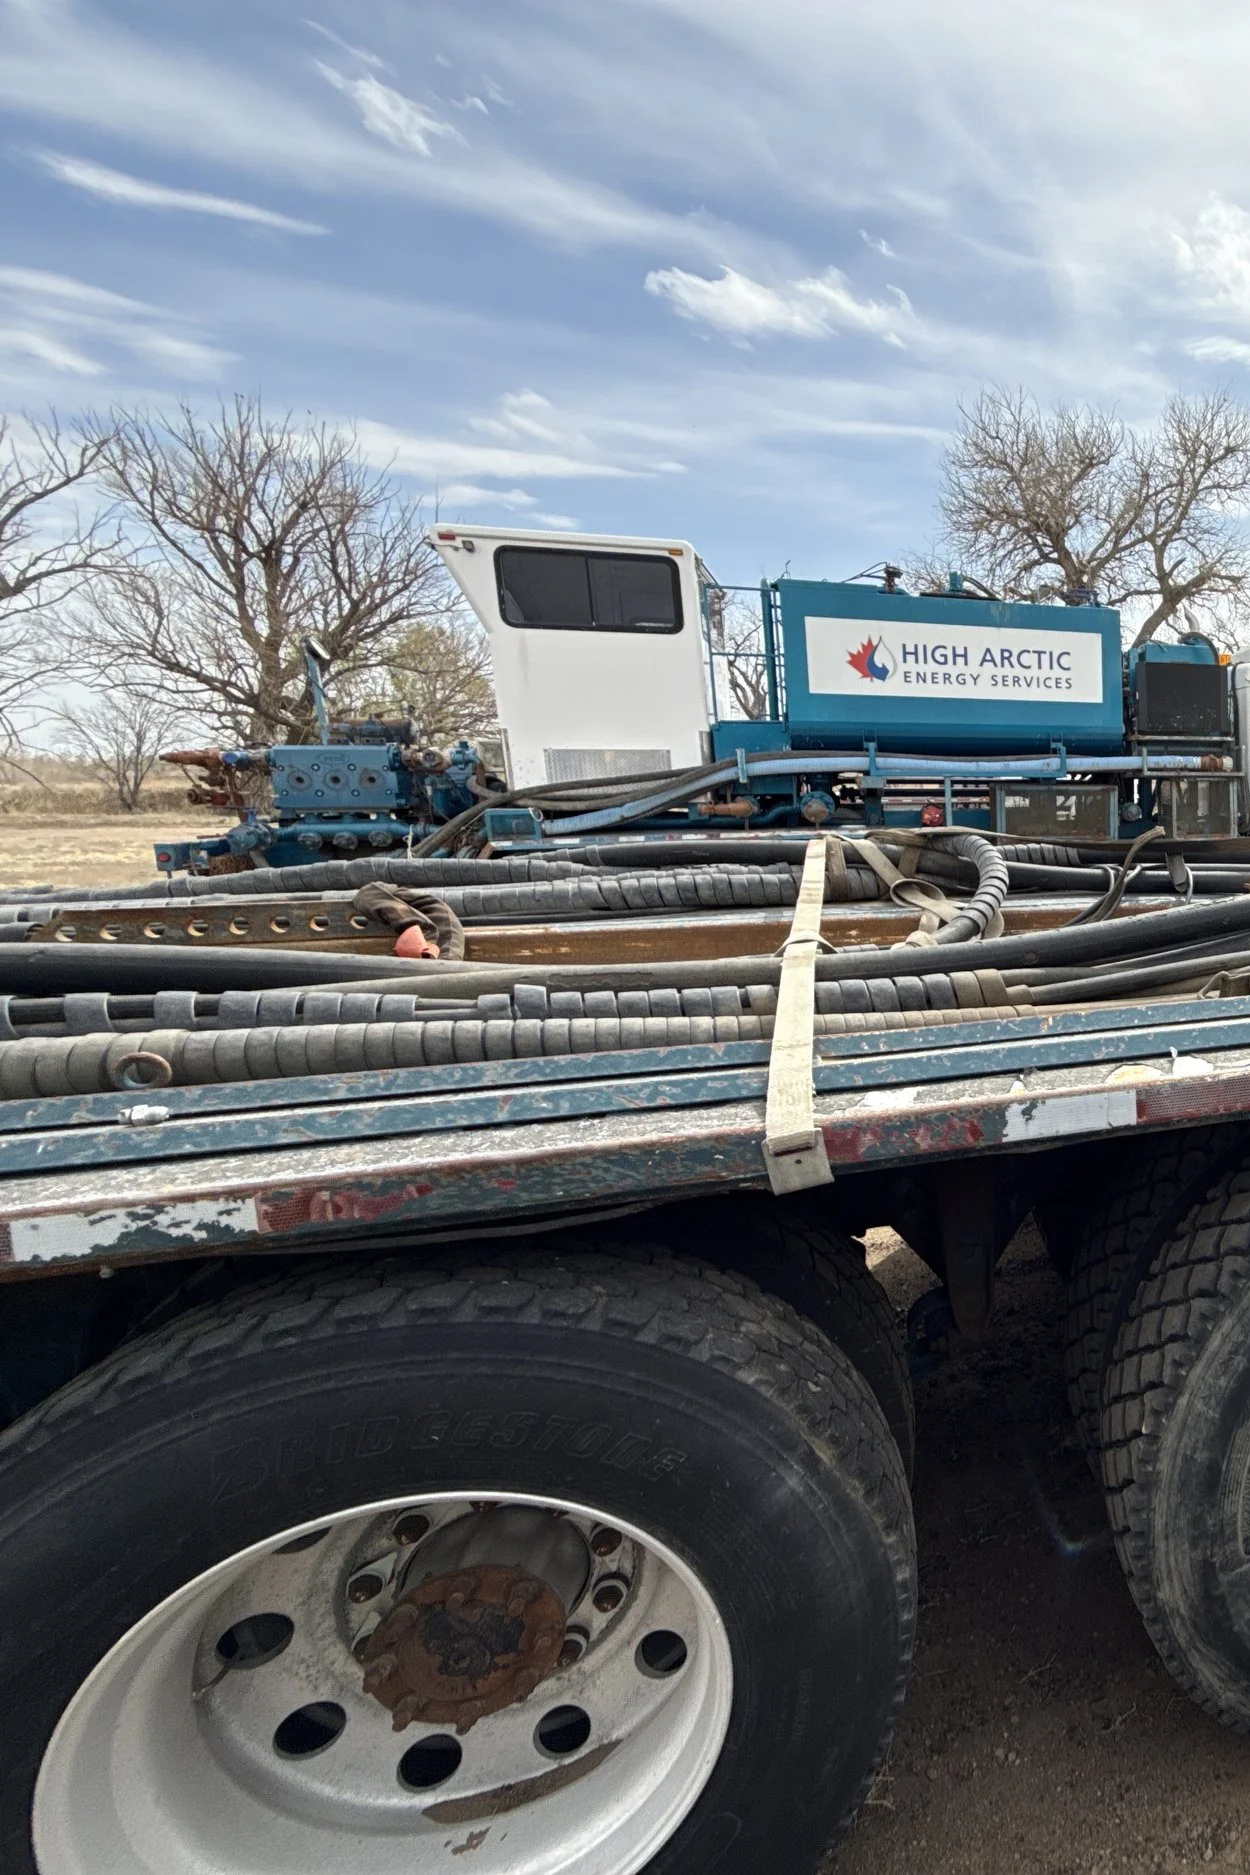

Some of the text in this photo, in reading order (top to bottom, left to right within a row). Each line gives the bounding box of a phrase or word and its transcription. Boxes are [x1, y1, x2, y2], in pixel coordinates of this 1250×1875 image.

[902, 643, 1071, 671] HIGH ARCTIC
[904, 671, 1073, 690] ENERGY SERVICES
[208, 1410, 689, 1507] BRIDGESTONE
